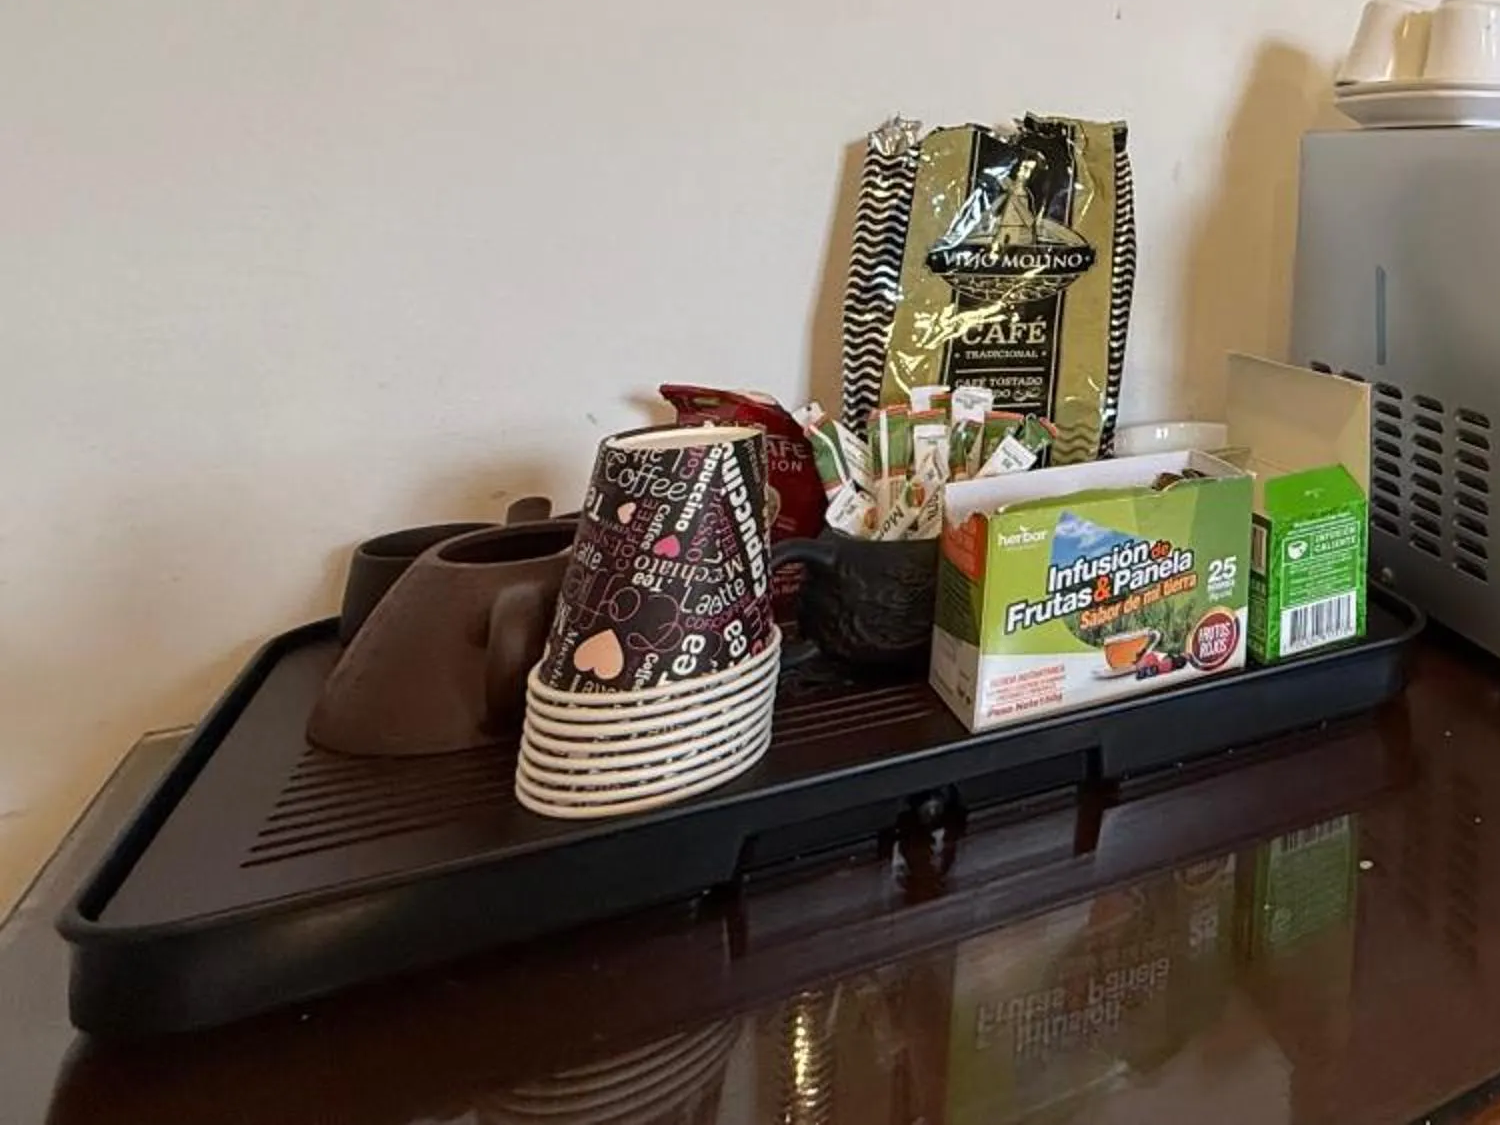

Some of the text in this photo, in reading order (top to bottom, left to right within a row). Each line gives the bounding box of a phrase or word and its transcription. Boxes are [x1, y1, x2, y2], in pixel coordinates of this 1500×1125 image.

[961, 315, 1048, 345] CAFÉ
[965, 348, 1039, 360] TRADICIONAL
[989, 375, 1044, 387] TOSTADO
[605, 462, 689, 503] Coffee
[1046, 539, 1173, 593] Infusión de
[1207, 554, 1238, 584] 25
[1004, 548, 1195, 634] Frutas & Panela
[1079, 601, 1121, 630] Sabor
[1123, 596, 1141, 615] de
[1142, 588, 1161, 607] mi
[1162, 572, 1198, 599] tierra
